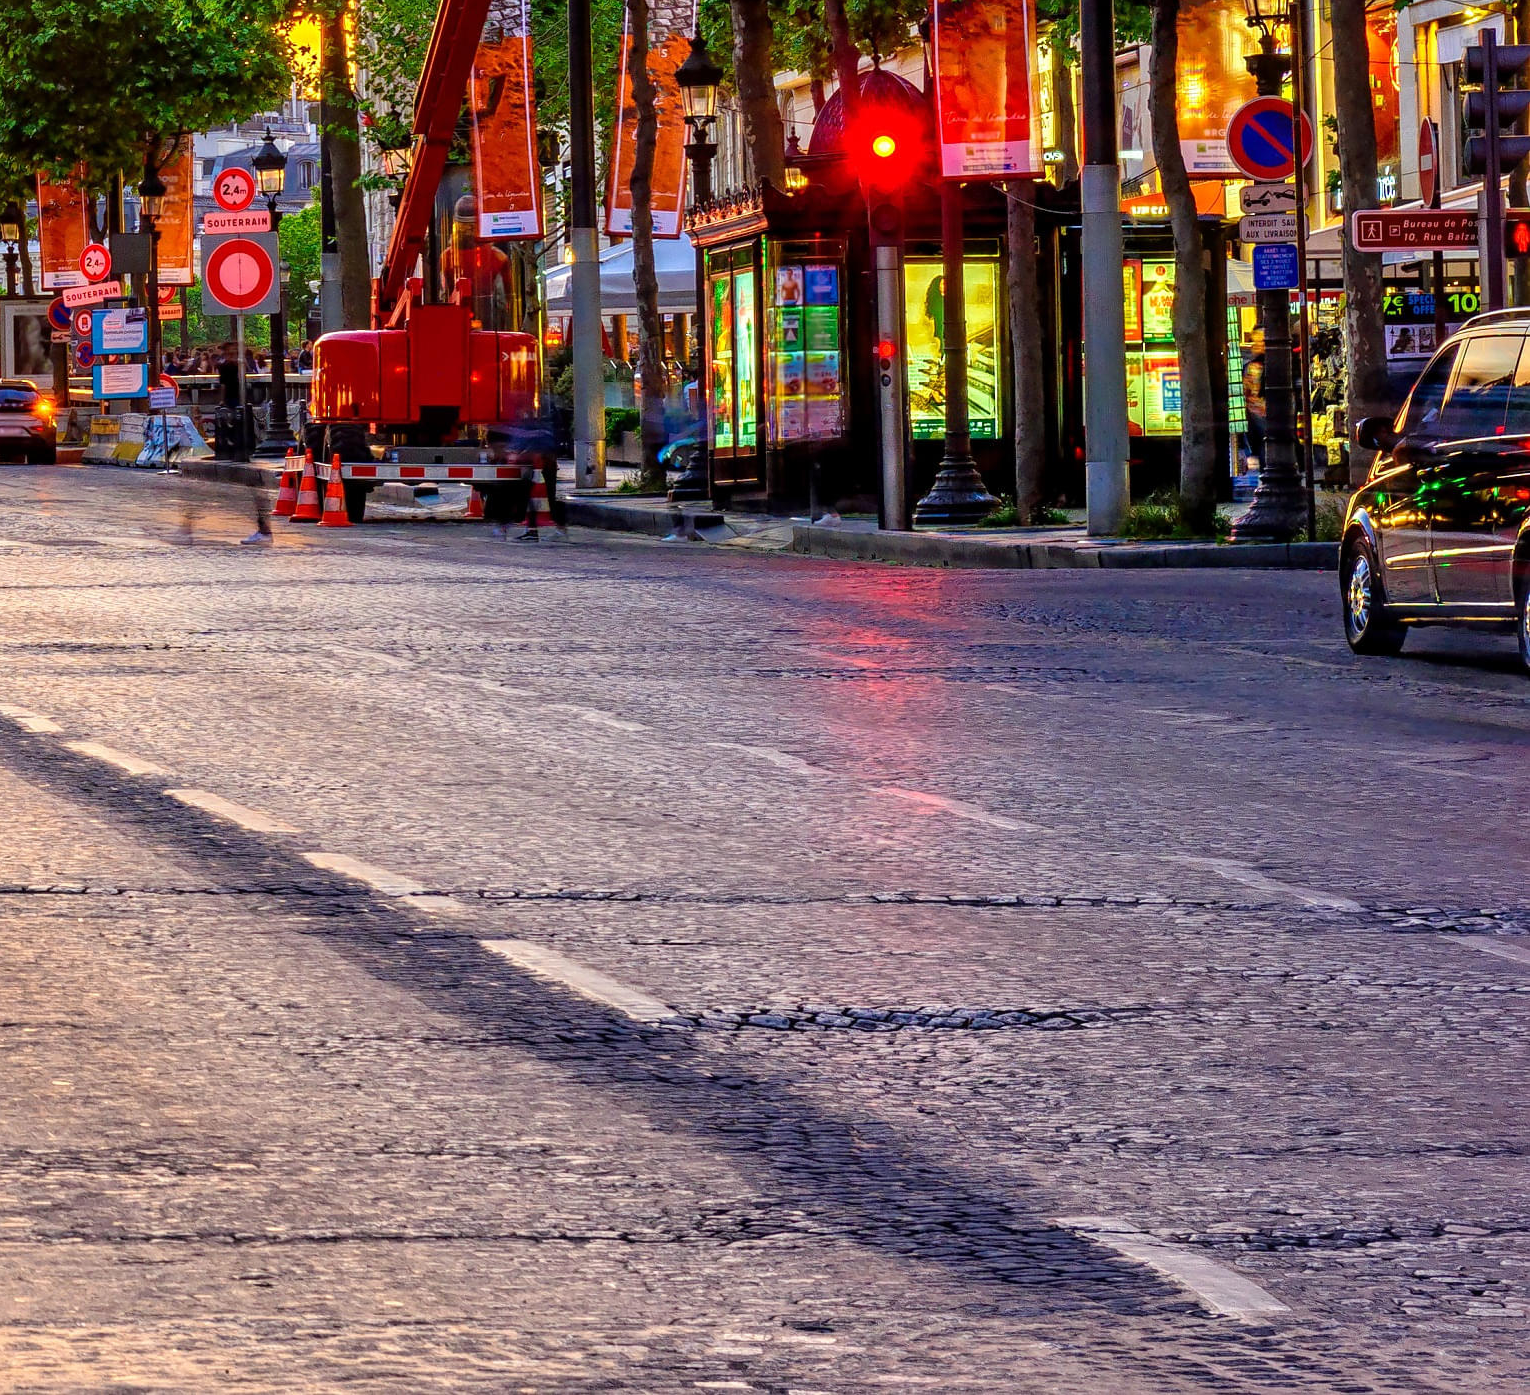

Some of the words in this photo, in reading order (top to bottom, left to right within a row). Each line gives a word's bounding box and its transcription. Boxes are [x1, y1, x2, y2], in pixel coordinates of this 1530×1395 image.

[222, 184, 247, 196] 2,4m
[207, 217, 268, 228] SOUTERRAIN
[1248, 219, 1278, 228] INTERDIT
[1281, 219, 1296, 227] SAU
[1403, 219, 1439, 228] Bureau
[1444, 218, 1456, 228] de
[1461, 218, 1479, 228] Pos
[1245, 230, 1260, 239] AUX
[1264, 230, 1297, 238] LIVRAISON
[1404, 232, 1418, 243] 10,
[1423, 232, 1442, 241] Rue
[1447, 232, 1479, 241] Balza
[66, 286, 118, 302] SOUTERRAIN
[1407, 293, 1436, 305] SPECI
[1413, 306, 1436, 315] OFFE
